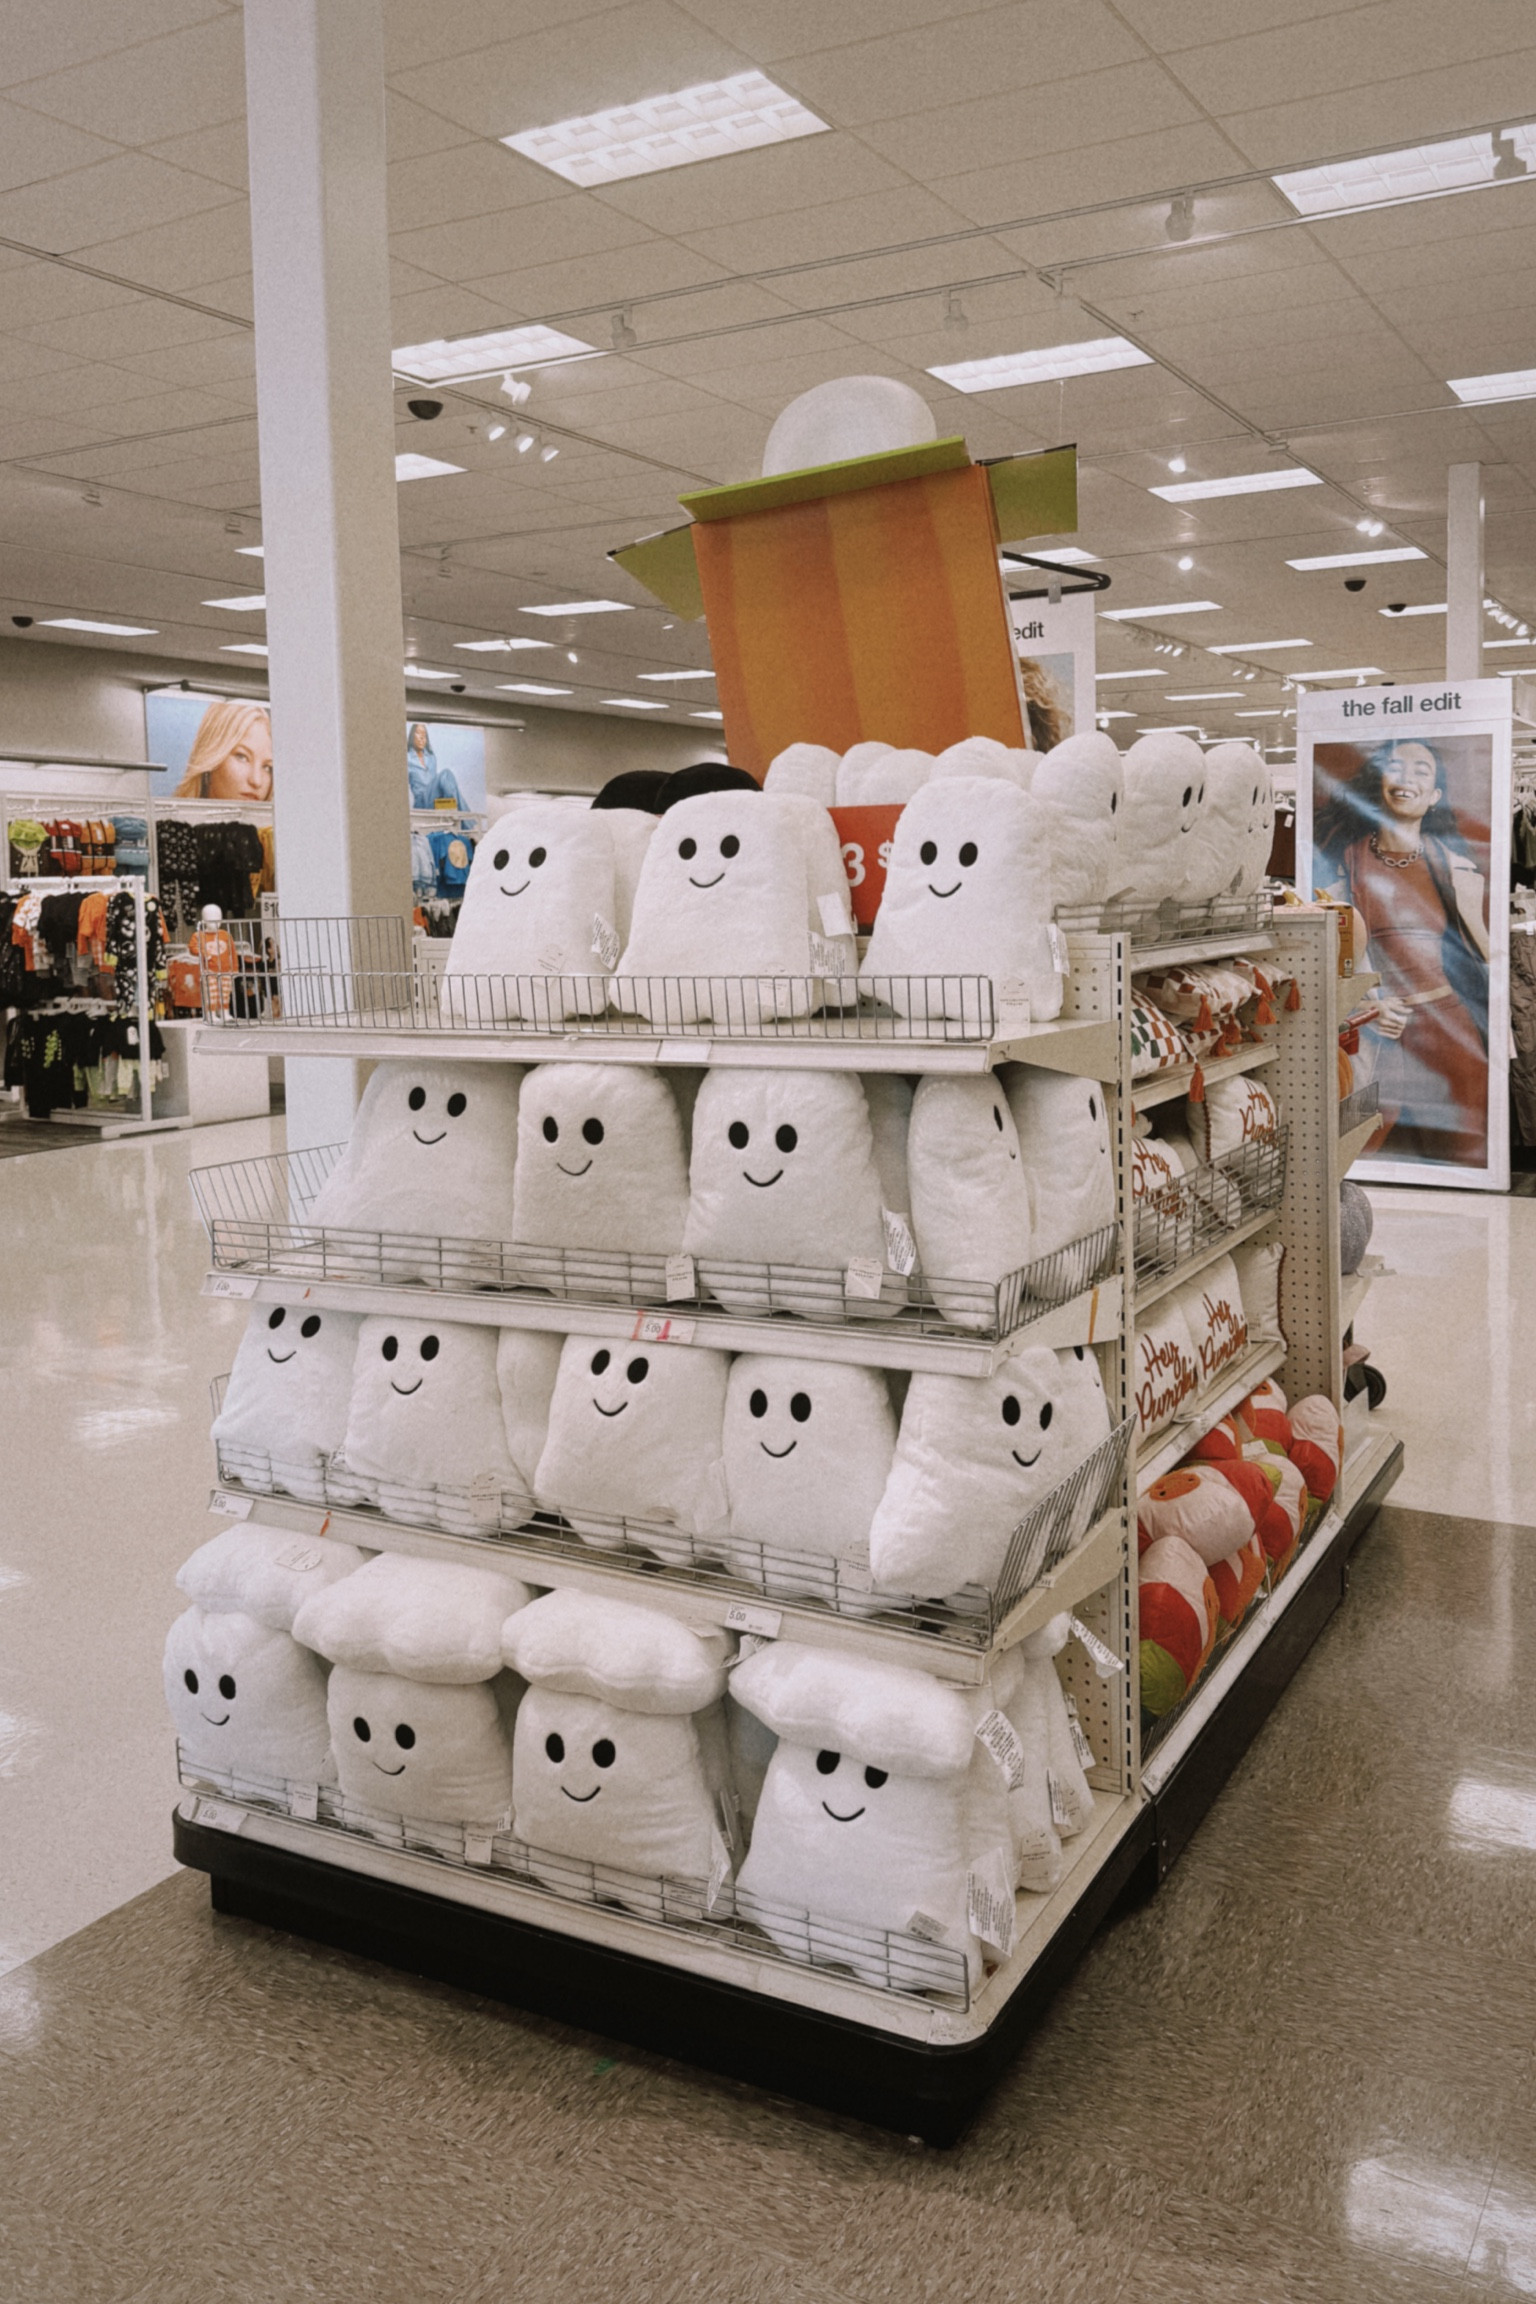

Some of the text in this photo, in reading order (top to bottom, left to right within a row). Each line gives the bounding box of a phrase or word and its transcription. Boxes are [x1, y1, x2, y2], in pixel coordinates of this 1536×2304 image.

[1014, 621, 1044, 640] edit
[1342, 692, 1461, 717] the fall edit
[842, 842, 866, 887] 3
[1132, 1136, 1172, 1191] Hey
[1202, 1293, 1234, 1337] Hey
[1140, 1333, 1180, 1383] Hey
[729, 1610, 746, 1622] 5.00
